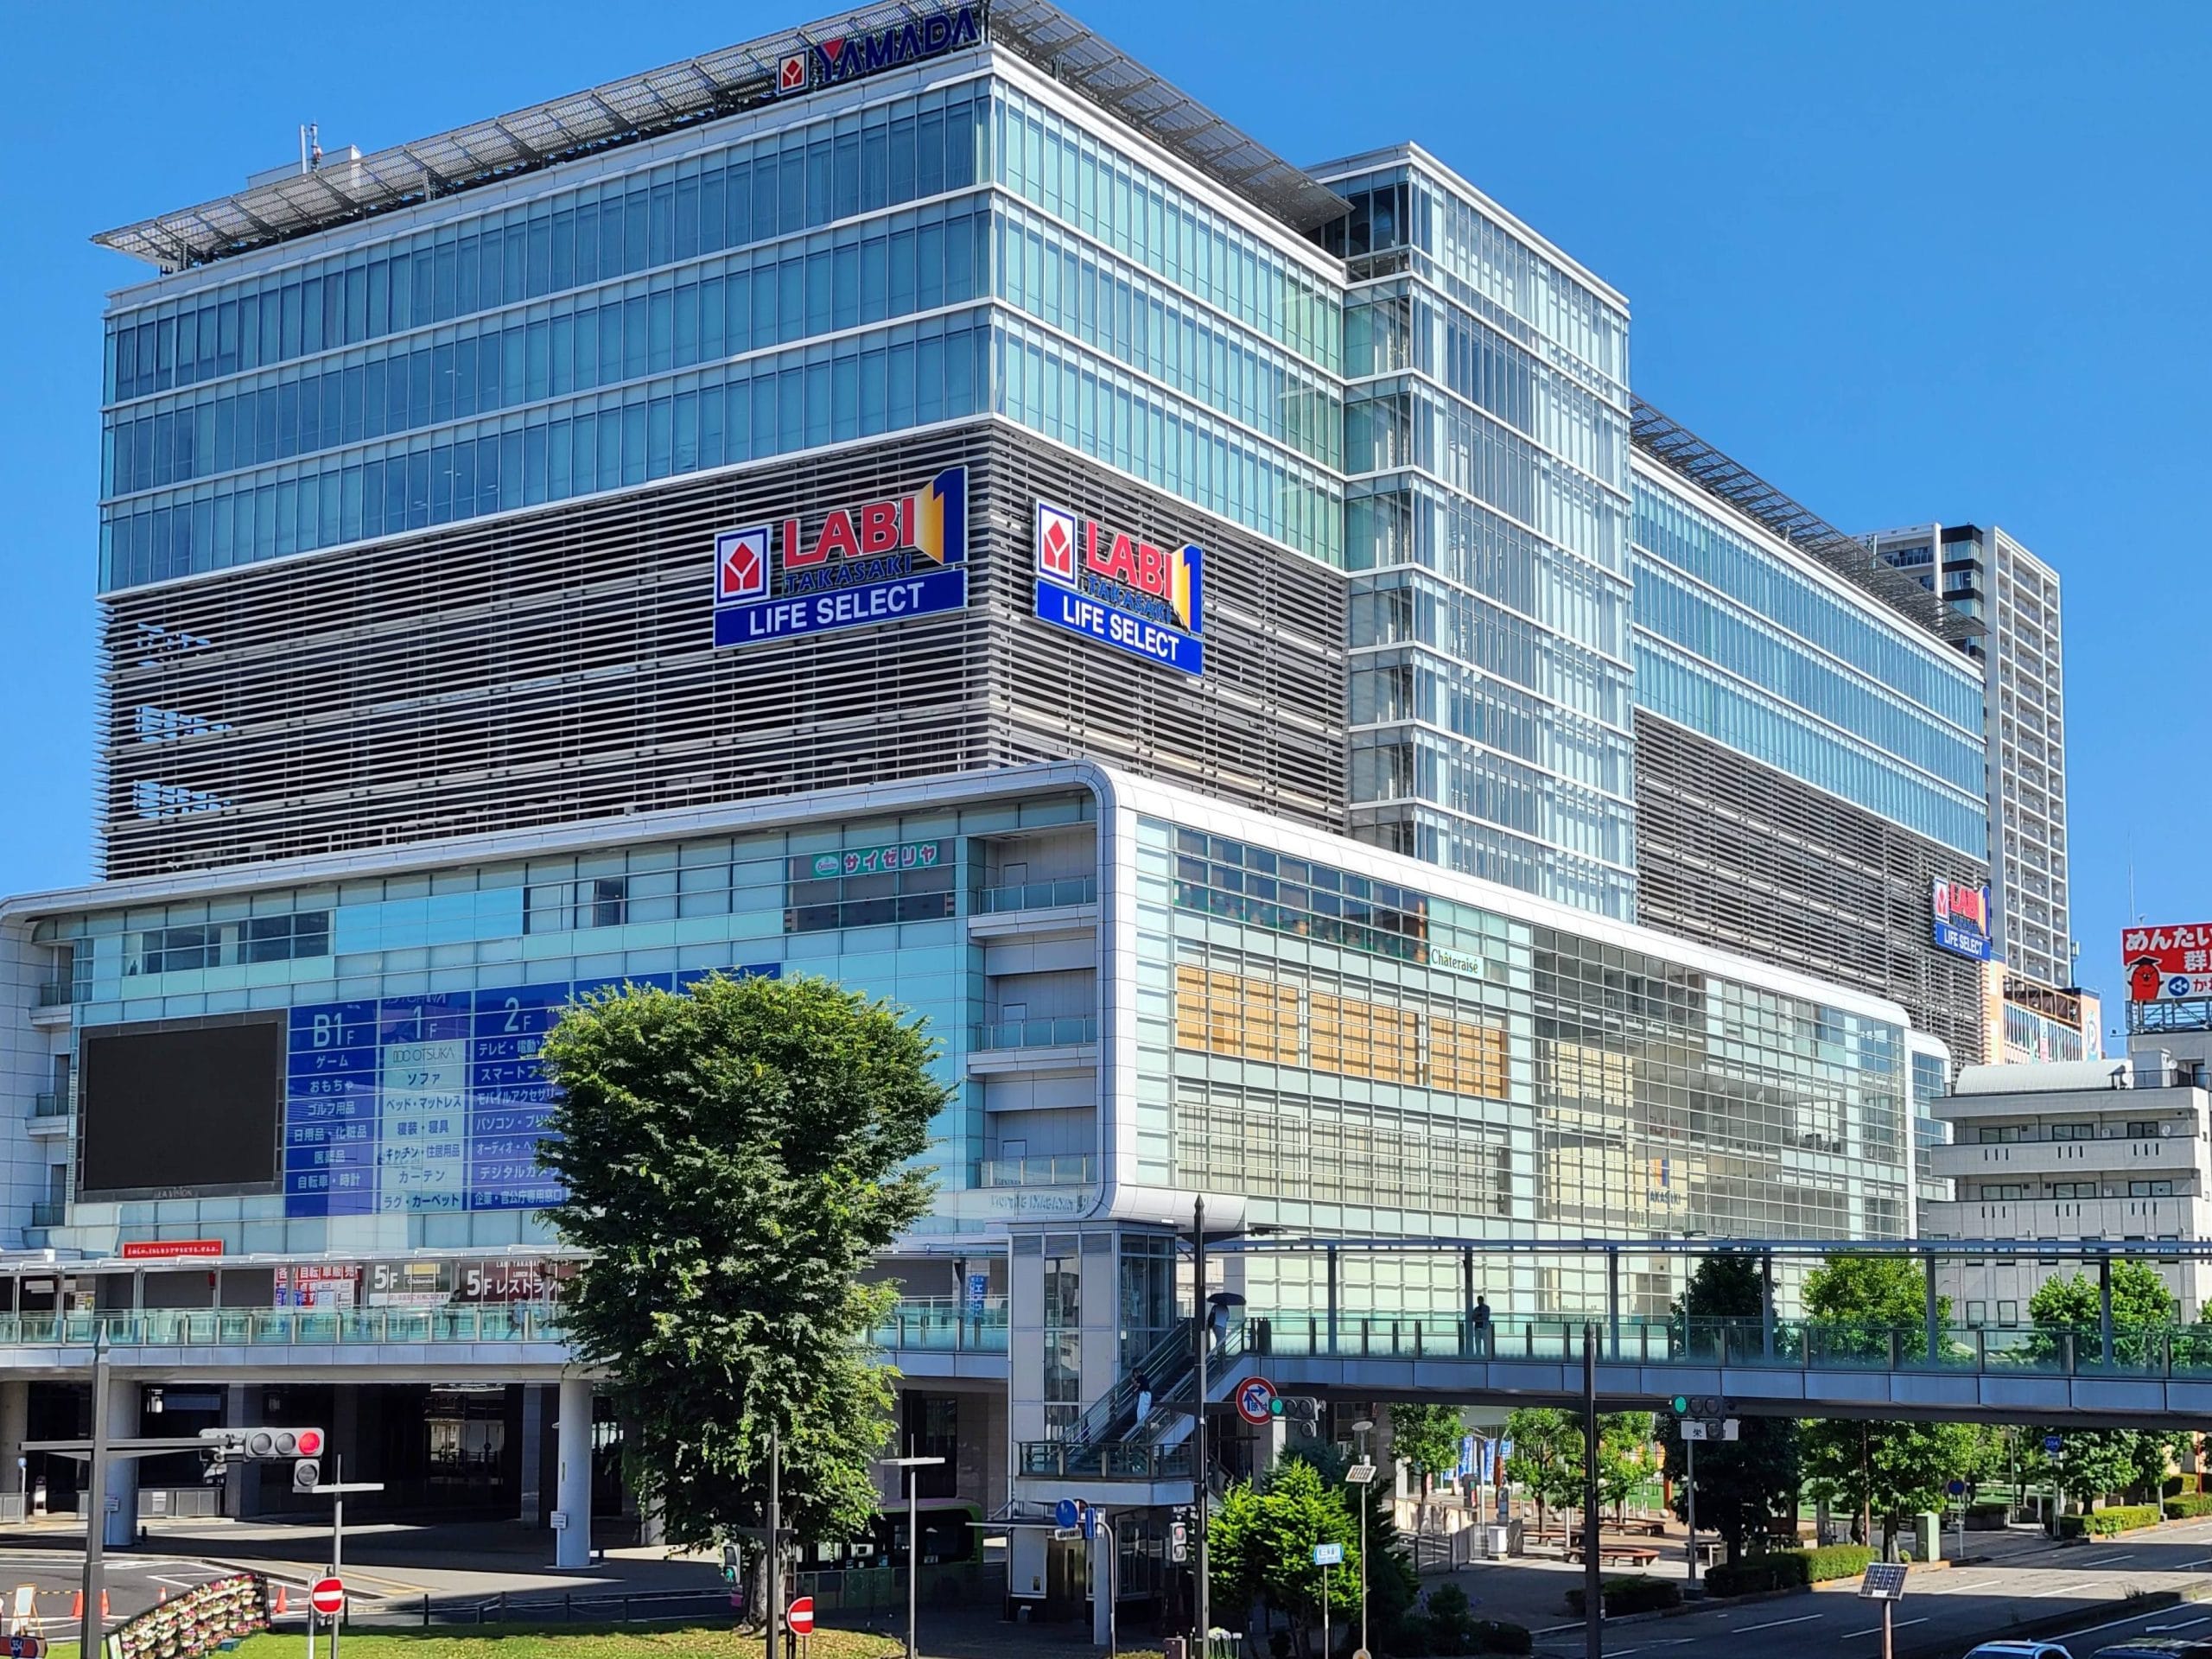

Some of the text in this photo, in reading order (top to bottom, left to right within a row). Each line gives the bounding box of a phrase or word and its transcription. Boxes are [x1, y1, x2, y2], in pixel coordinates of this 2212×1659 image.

[813, 7, 980, 84] YAMADA
[783, 496, 917, 570] LABI
[1086, 518, 1173, 601] LABI
[785, 554, 912, 594] TAKASAKI
[749, 582, 925, 636] LIFE SELECT
[1087, 575, 1173, 624] TAKASAKI
[1063, 595, 1179, 662] LIFE SELECT
[843, 844, 938, 874] サイゼリヤ
[1944, 928, 1983, 957] LIFE SELECT
[2183, 950, 2212, 972] 群
[315, 1054, 349, 1070] ゲーム
[413, 1046, 456, 1062] OTSUKA
[309, 1079, 354, 1094] おもちゃ
[407, 1072, 441, 1086] ソファ
[308, 1101, 356, 1116] ゴルフ用品
[386, 1095, 462, 1111] ベッド・マットレス
[294, 1124, 367, 1142] 日用品・化粧品
[297, 1173, 360, 1189] 自転車・時計
[398, 1170, 445, 1184] カーテン
[384, 1193, 460, 1209] ラグ・カーペット
[374, 1264, 398, 1289] 5F
[467, 1269, 493, 1296] 5F
